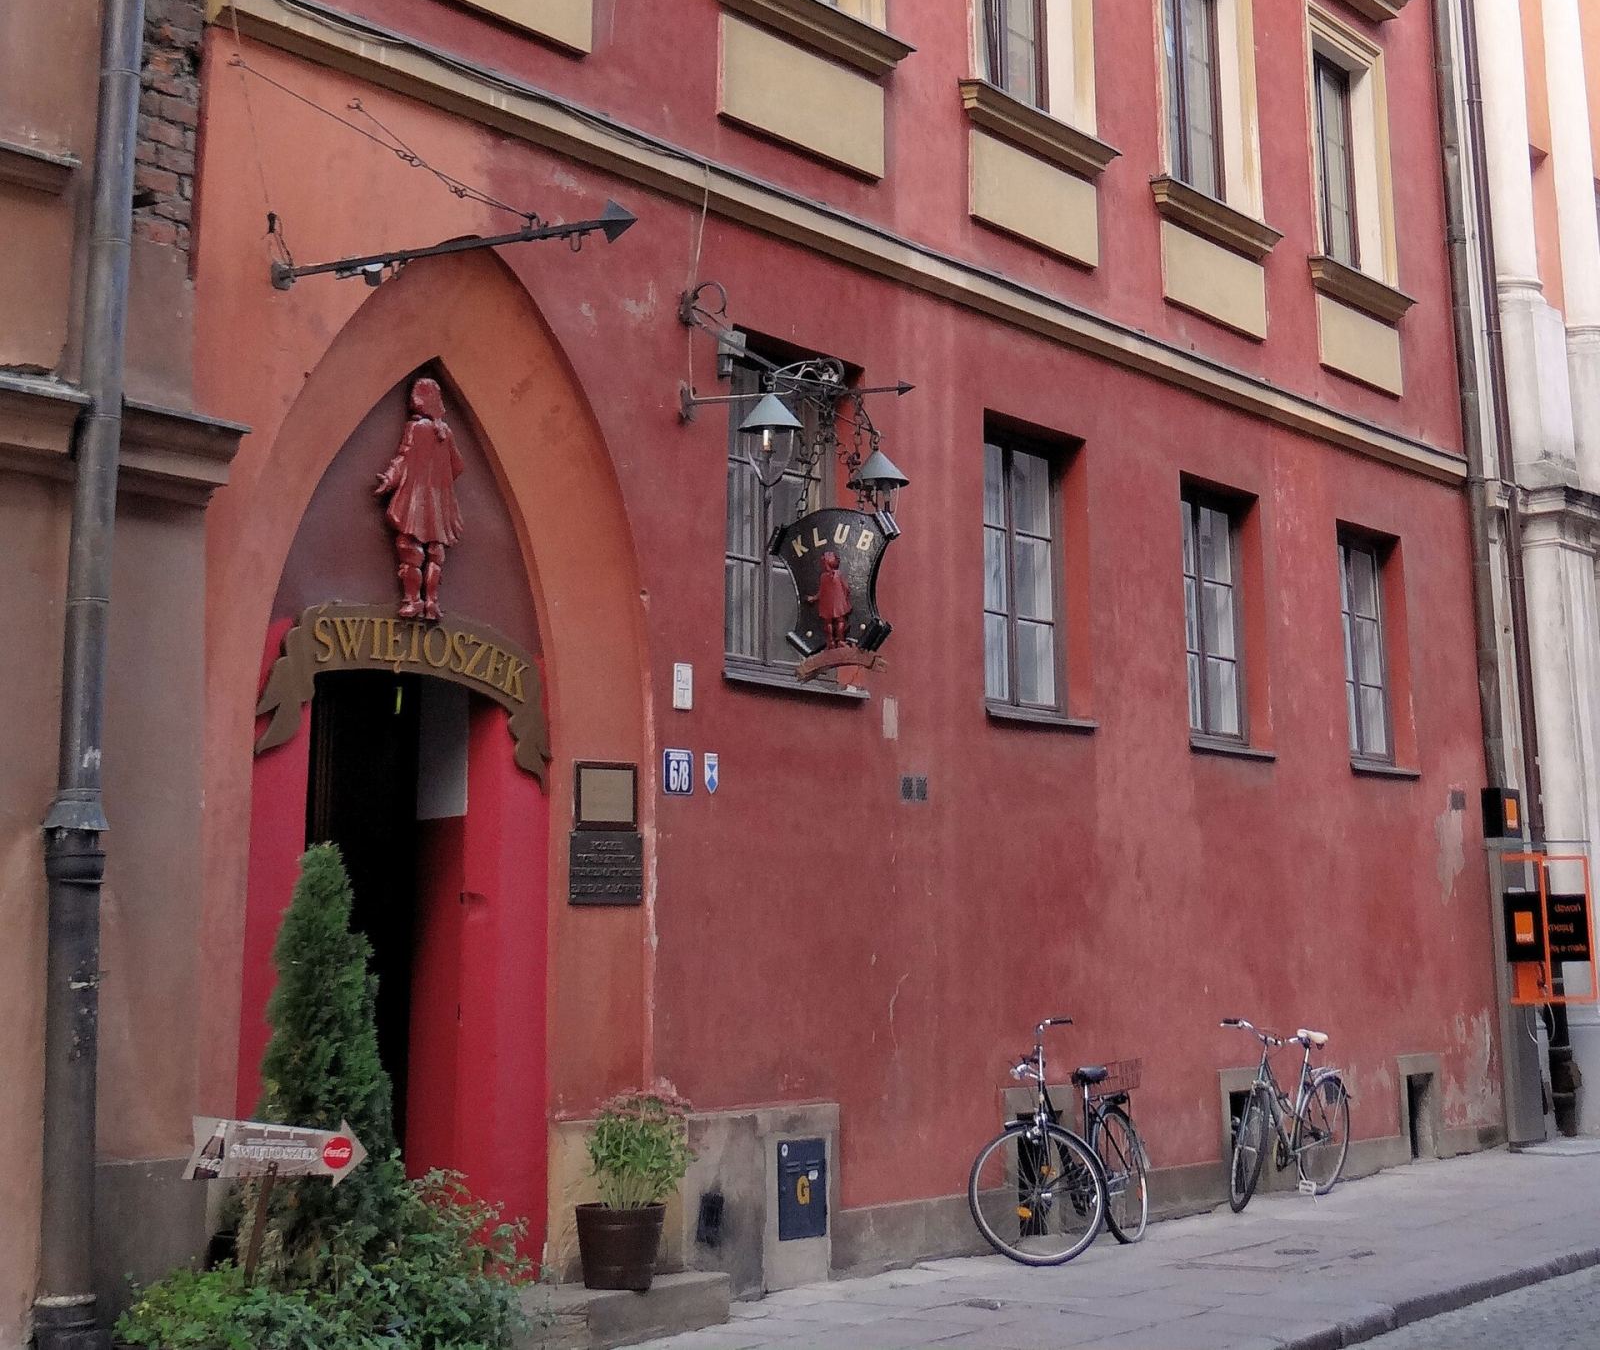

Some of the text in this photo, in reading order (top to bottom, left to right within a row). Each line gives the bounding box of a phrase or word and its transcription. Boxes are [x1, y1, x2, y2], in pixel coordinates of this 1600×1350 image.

[792, 523, 875, 558] KLUB
[314, 605, 529, 703] ŚWIĘTOSZEK
[669, 760, 689, 791] 6/8
[797, 1175, 810, 1205] G
